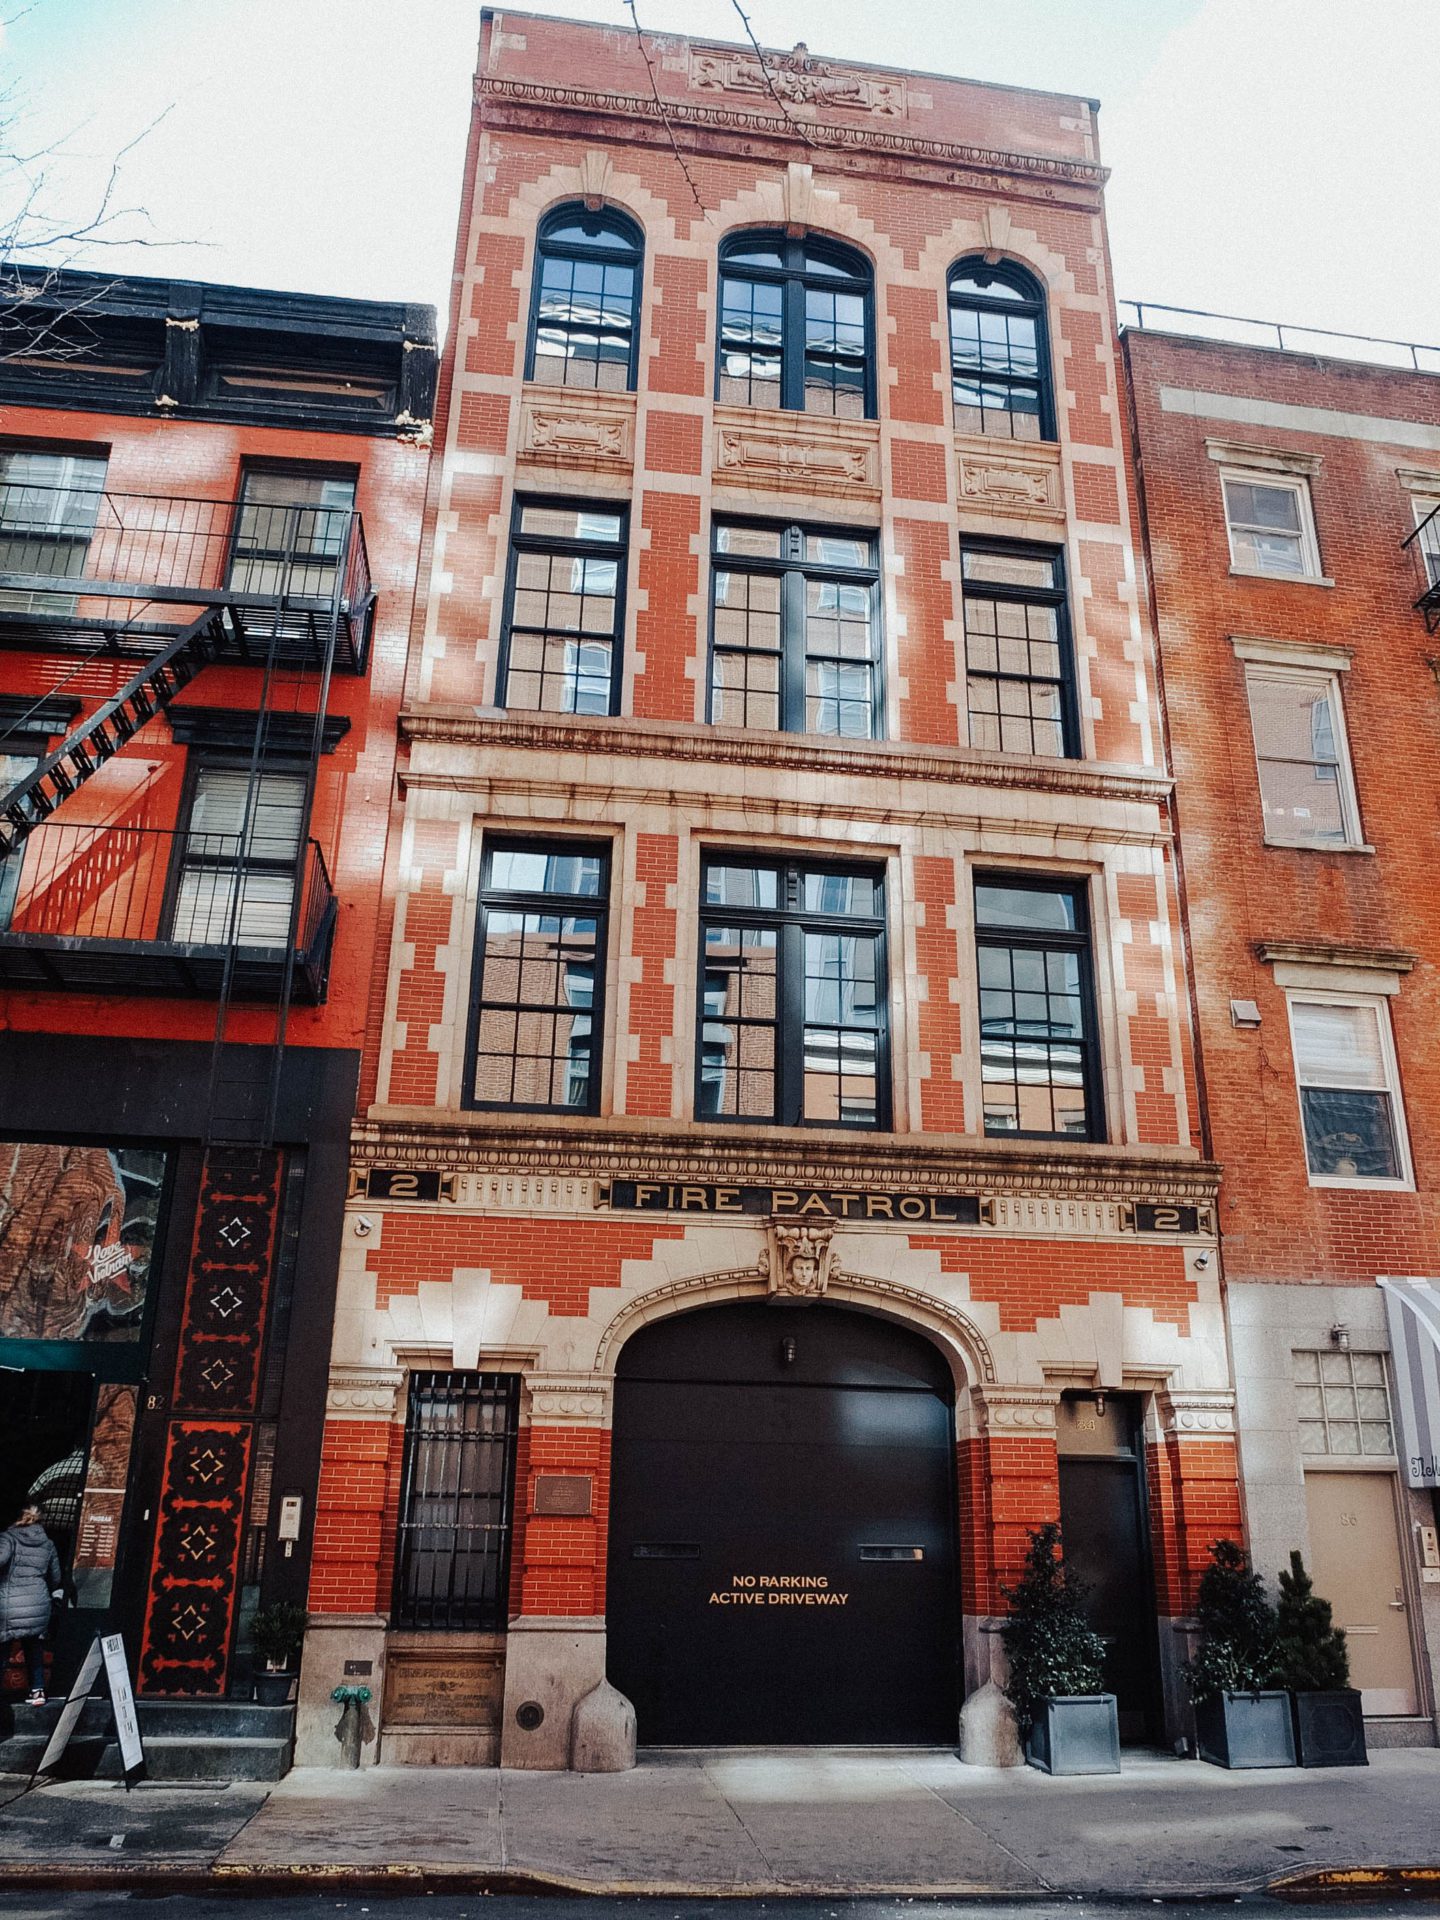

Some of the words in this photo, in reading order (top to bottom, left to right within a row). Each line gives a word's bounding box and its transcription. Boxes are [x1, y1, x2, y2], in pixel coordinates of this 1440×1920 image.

[389, 1174, 419, 1197] 2
[635, 1184, 743, 1211] FIRE
[771, 1190, 958, 1220] PATROL
[1153, 1208, 1180, 1230] 2
[92, 1241, 124, 1264] love
[733, 1576, 756, 1587] NO
[760, 1576, 828, 1588] PARKING
[709, 1592, 765, 1604] ACTIVE
[769, 1593, 848, 1605] DRIVEWAY
